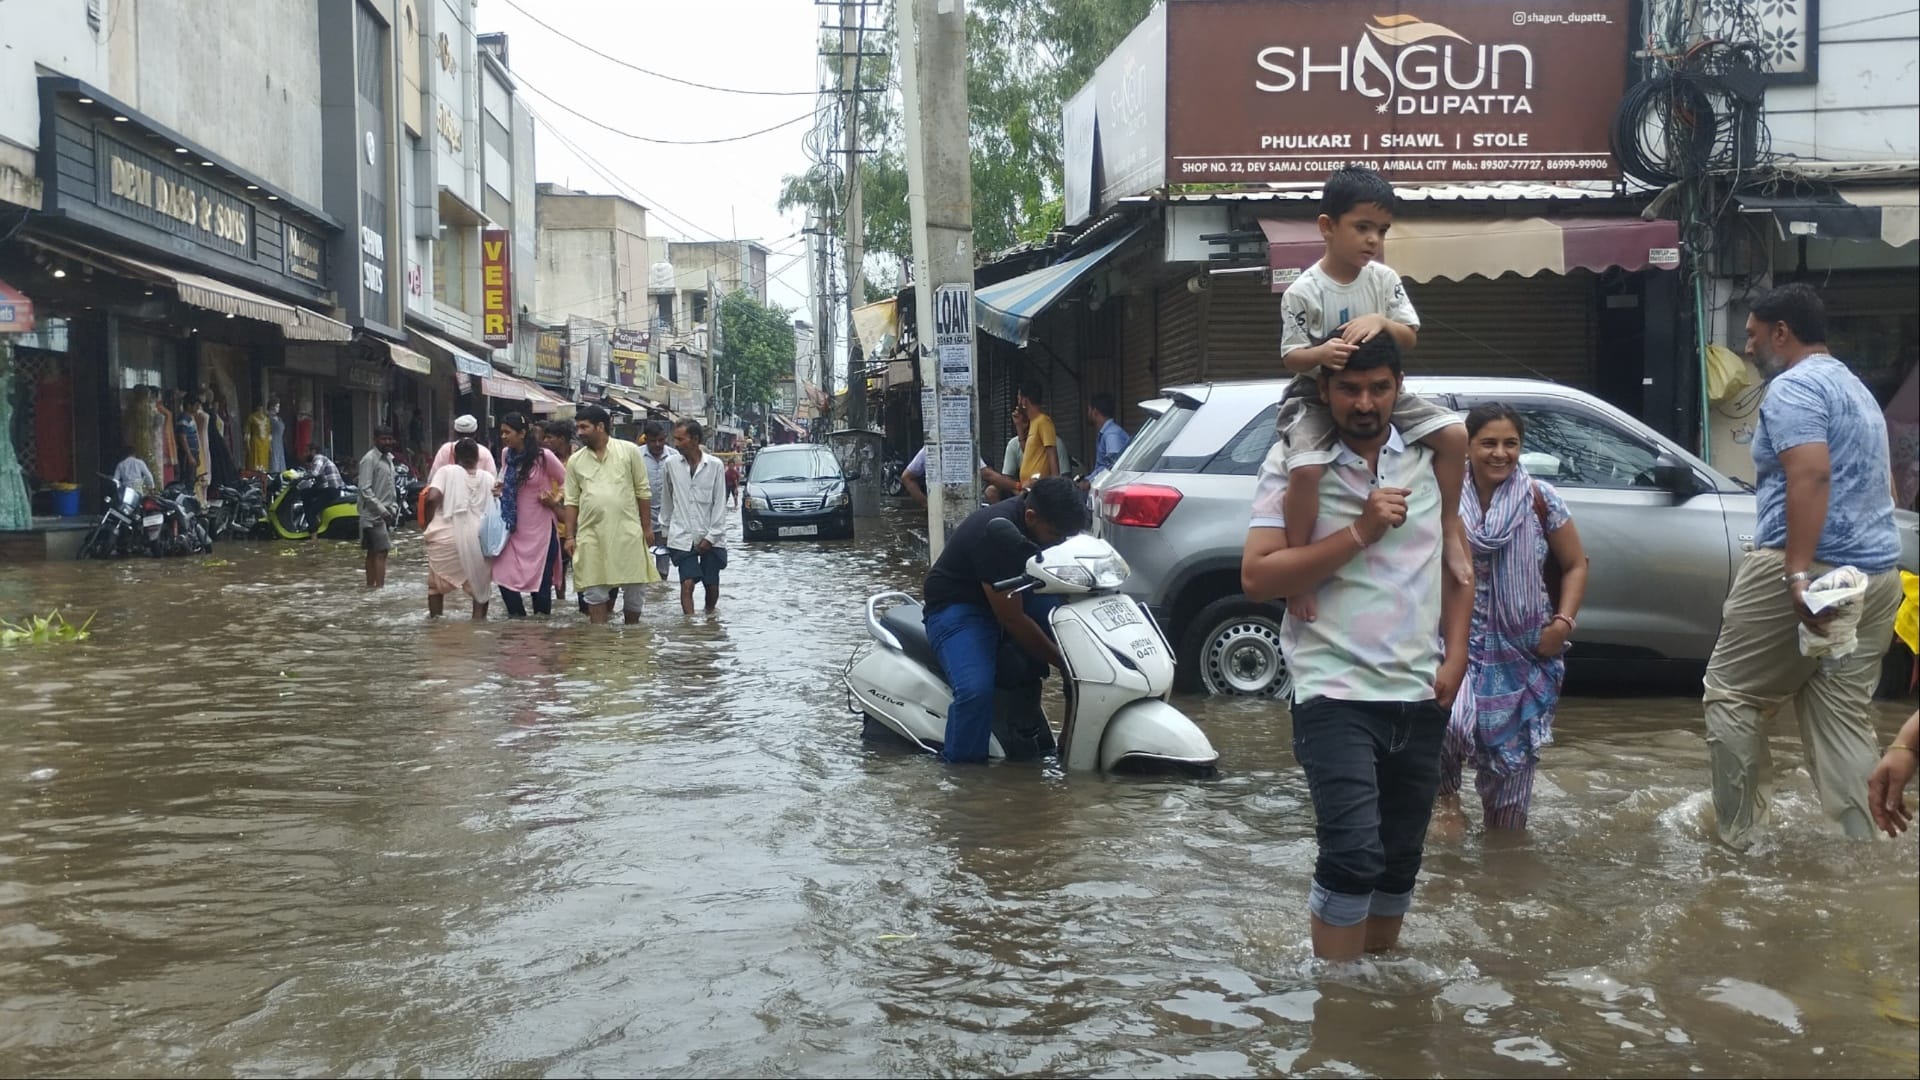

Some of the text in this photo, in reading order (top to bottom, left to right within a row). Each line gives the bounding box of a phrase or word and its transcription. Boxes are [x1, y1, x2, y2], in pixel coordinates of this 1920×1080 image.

[1527, 12, 1613, 24] shagun_dupatta_
[1397, 95, 1533, 115] DUPATTA
[1261, 133, 1529, 149] PHULKARI SHAWL STOLE
[1182, 162, 1208, 173] SHOP
[1211, 162, 1228, 172] NO.
[1231, 162, 1245, 174] 22,
[1247, 162, 1266, 172] DEV
[1268, 161, 1301, 172] SAMAJ
[1304, 161, 1346, 171] COLLEGE
[1382, 160, 1424, 171] AMBALA
[1426, 160, 1448, 170] CITY
[1546, 159, 1609, 170] 86999-99906
[199, 195, 213, 232] &
[213, 203, 247, 246] SONS
[484, 241, 507, 334] VEER
[935, 290, 969, 334] LOAN
[1136, 646, 1158, 659] 0477
[867, 689, 905, 707] Activa
